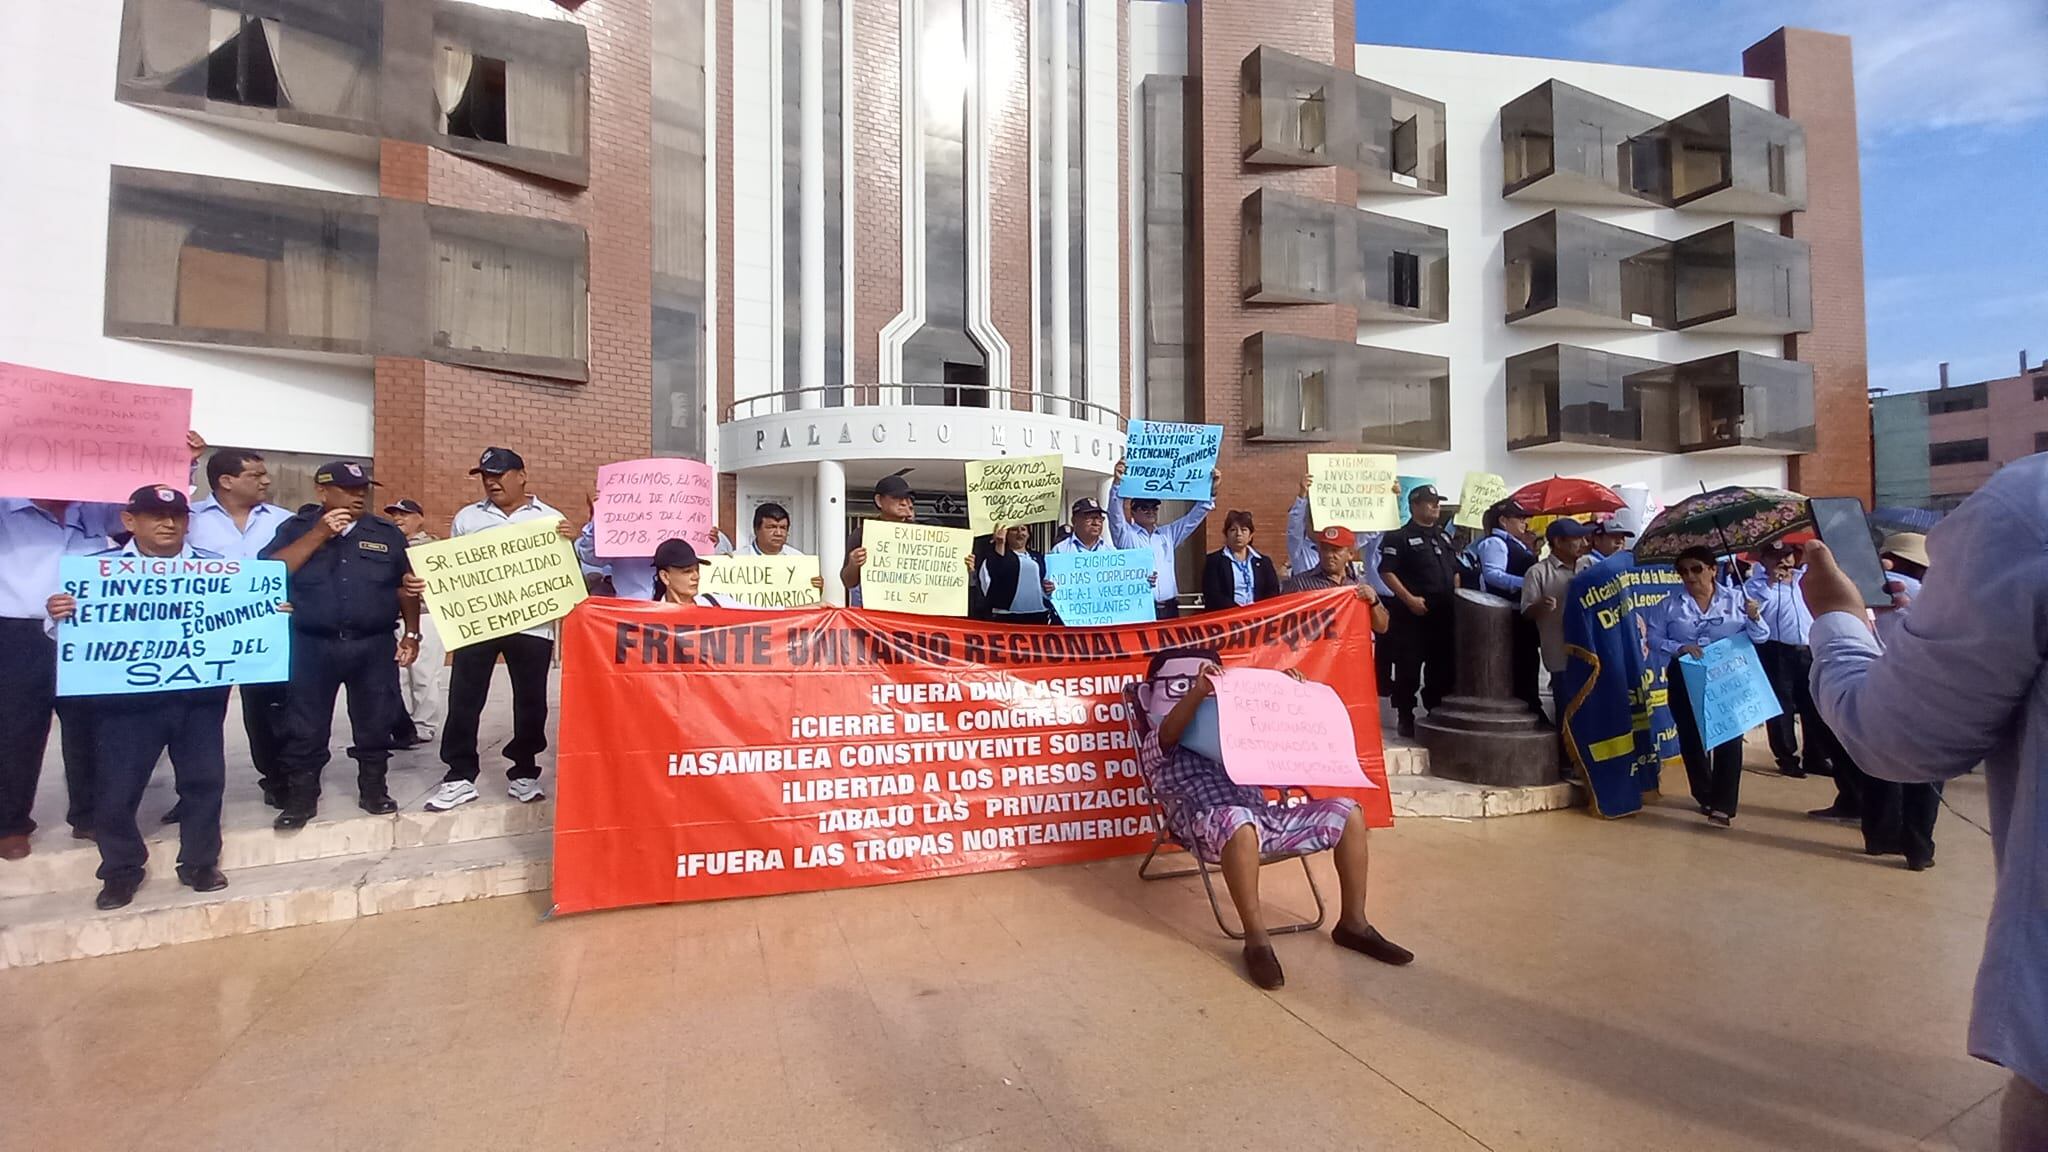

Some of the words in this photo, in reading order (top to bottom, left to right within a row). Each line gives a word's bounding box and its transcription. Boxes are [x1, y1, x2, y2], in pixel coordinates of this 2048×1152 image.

[756, 422, 952, 450] PALACIO
[1144, 422, 1205, 434] EXIGIMOS
[1141, 434, 1196, 446] INVESTIGUE
[1200, 434, 1217, 446] LAS
[676, 474, 690, 486] EL
[1130, 466, 1176, 480] INDEBIDAS
[1185, 469, 1204, 480] DEL
[606, 492, 642, 504] TOTAL
[648, 492, 664, 504] DE
[604, 511, 653, 523] DEUDAS
[894, 527, 950, 543] EXIGIMOS
[426, 555, 453, 572] SR.
[455, 544, 498, 566] ELBER
[500, 531, 557, 557] REQUEJO
[876, 541, 890, 553] SE
[897, 542, 959, 559] INVESTIGUE
[100, 559, 241, 577] EXIGIMOS
[873, 555, 891, 568] LAS
[897, 557, 958, 573] RETENCIONES
[1074, 554, 1126, 569] EXIGIMOS
[427, 578, 450, 595] LA
[450, 553, 562, 593] MUNICIPALIDAD
[710, 565, 773, 584] ALCALDE
[786, 565, 796, 584] Y
[1052, 573, 1066, 586] NO
[1070, 571, 1091, 584] MAS
[65, 581, 90, 599] SE
[101, 577, 233, 599] INVESTIGUE
[249, 576, 283, 595] LAS
[440, 602, 466, 620] NO
[468, 595, 488, 614] ES
[488, 590, 518, 608] UNA
[520, 574, 575, 598] AGENCIA
[909, 591, 929, 604] SAT
[65, 600, 205, 627] RETENCIONES
[181, 596, 284, 639] ECONOMICAS
[458, 620, 483, 639] DE
[487, 598, 560, 632] EMPLEOS
[62, 644, 74, 661] E
[85, 639, 206, 662] INDEBIDAS
[231, 638, 269, 655] DEL
[615, 621, 772, 665] FRENTE
[787, 626, 952, 668] UNITARIO
[964, 631, 1132, 666] REGIONAL
[872, 682, 963, 705] ¡FUERA
[1234, 696, 1281, 713] RETIRO
[791, 714, 895, 739] ¡CIERRE
[904, 712, 949, 735] DEL
[956, 703, 1088, 733] CONGRESO
[667, 747, 832, 779] ¡ASAMBLEA
[839, 736, 1041, 768] CONSTITUYENTE
[782, 773, 916, 805] ¡LIBERTAD
[922, 773, 942, 794] A
[948, 769, 994, 793] LOS
[1001, 760, 1097, 788] PRESOS
[818, 806, 915, 835] ¡ABAJO
[922, 799, 970, 824] LAS
[677, 849, 785, 879] ¡FUERA
[794, 842, 845, 870] LAS
[853, 833, 954, 864] TROPAS
